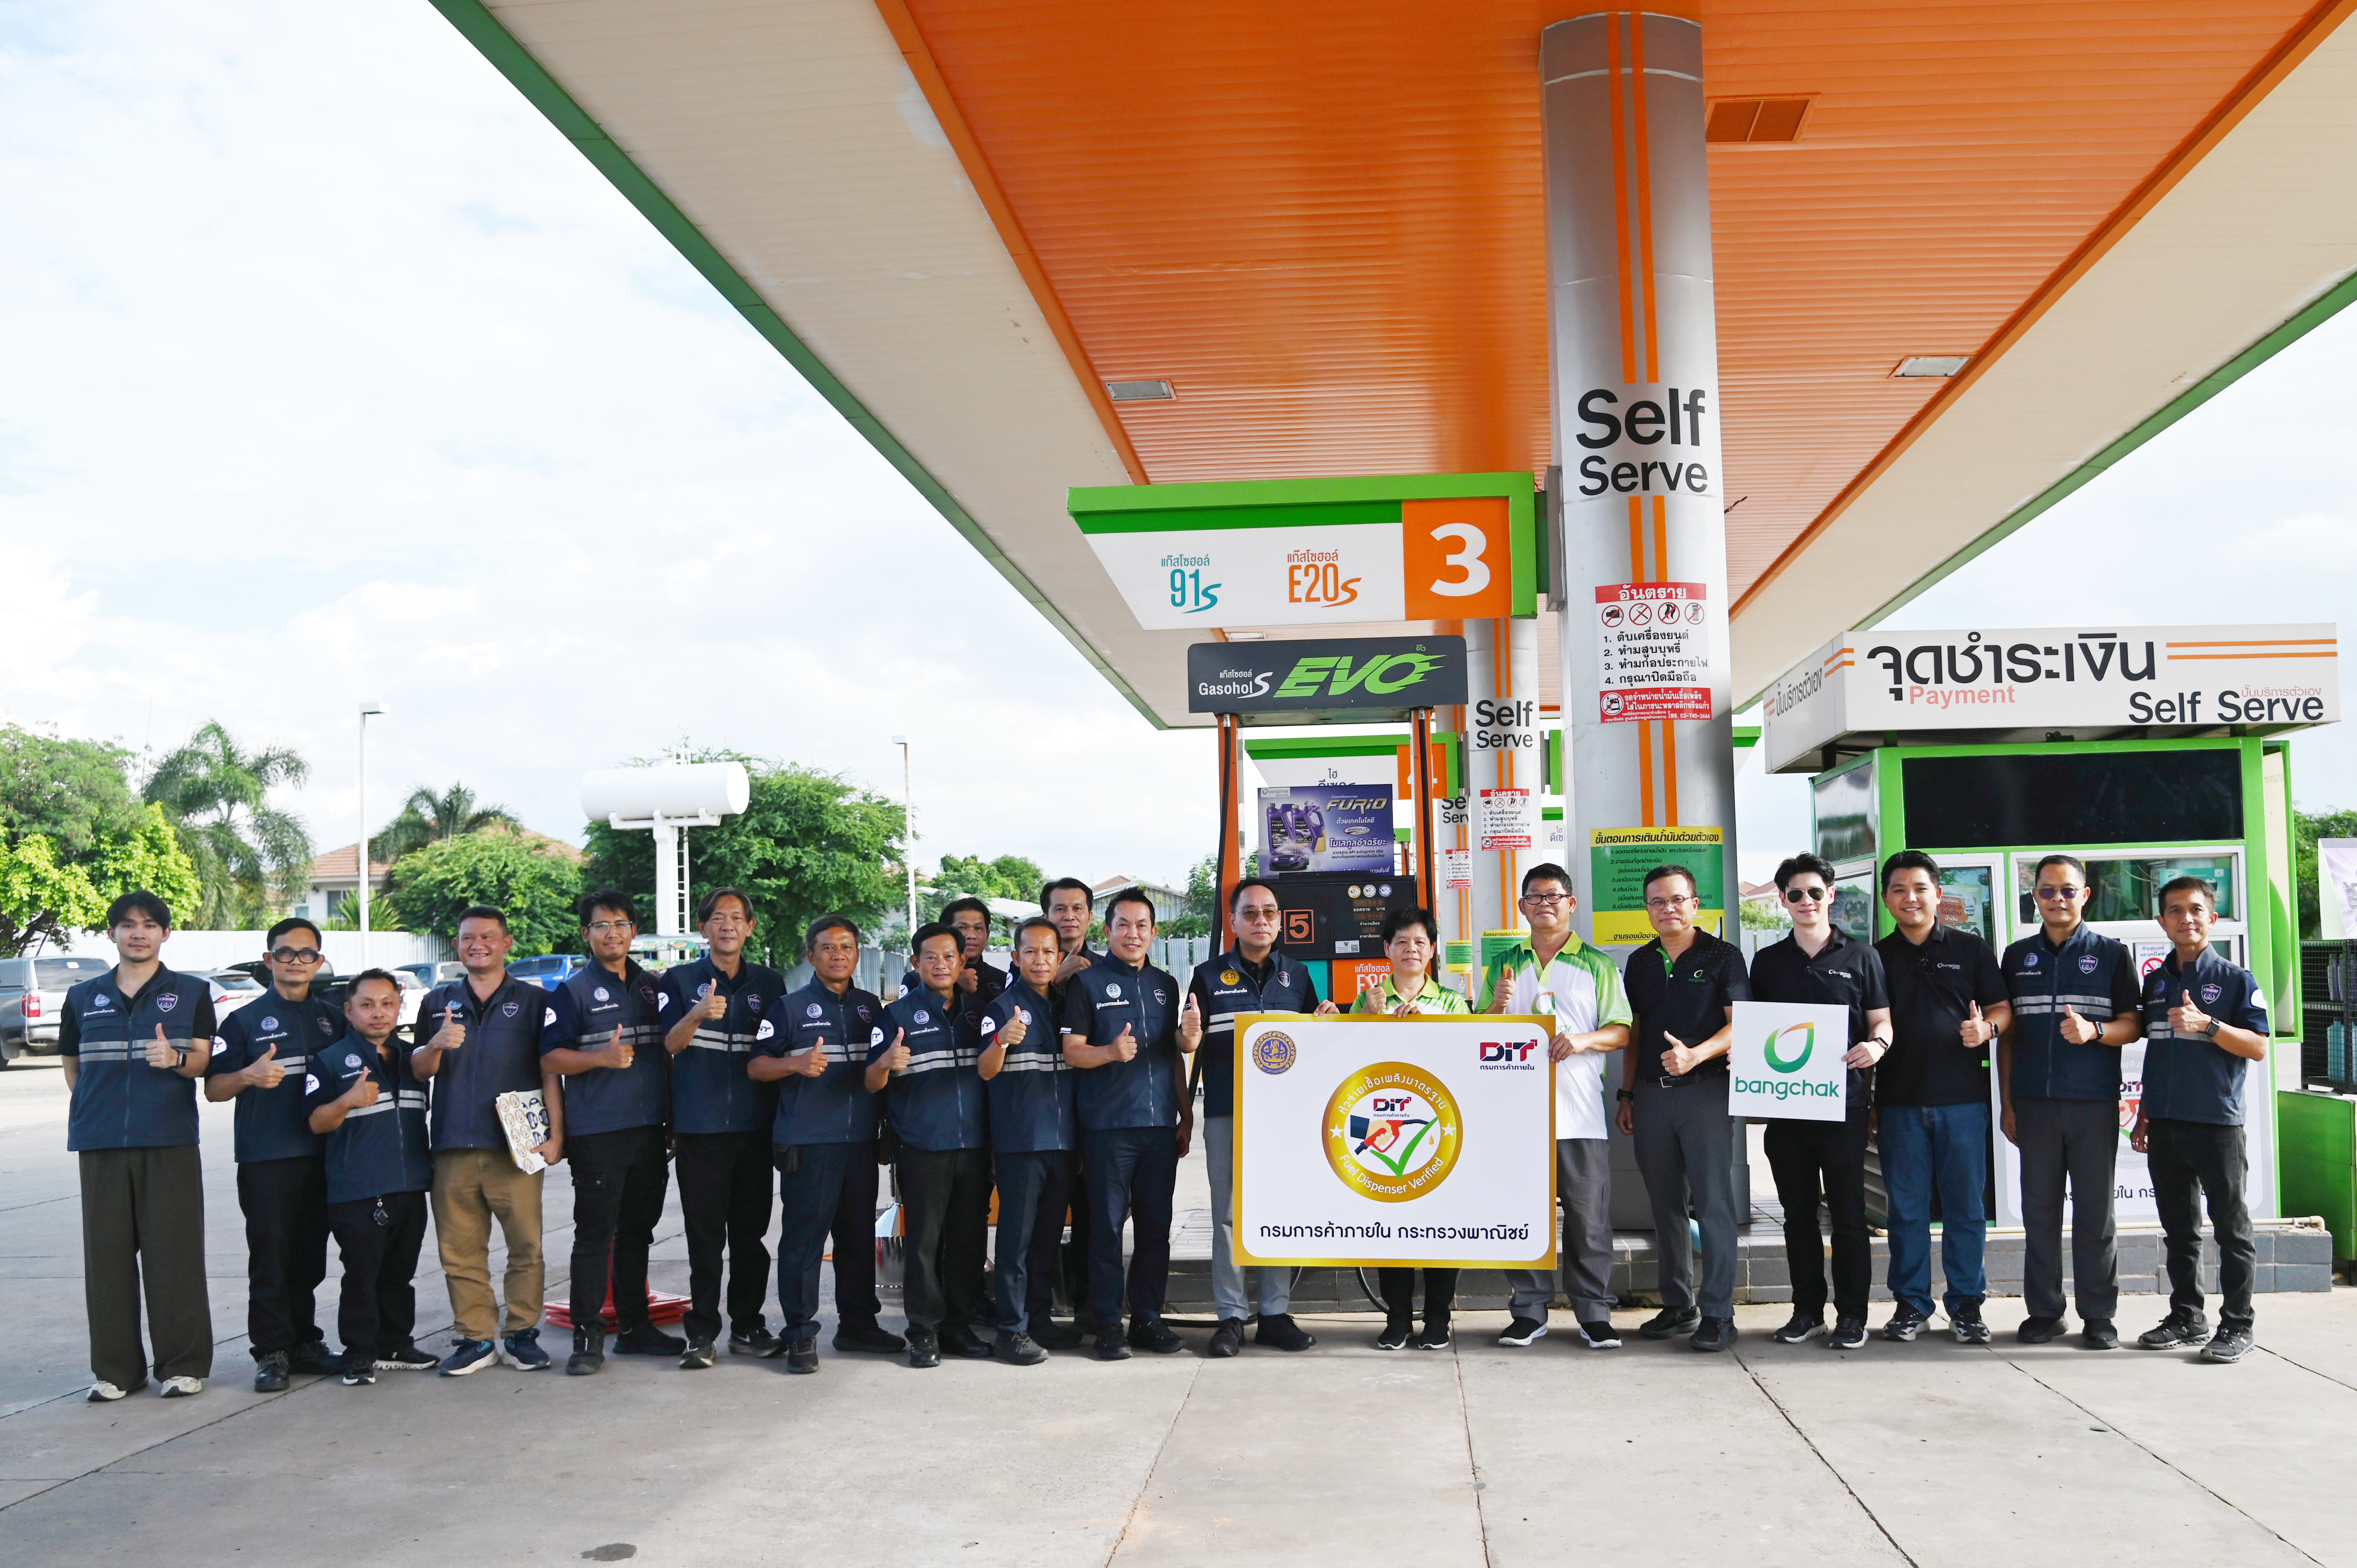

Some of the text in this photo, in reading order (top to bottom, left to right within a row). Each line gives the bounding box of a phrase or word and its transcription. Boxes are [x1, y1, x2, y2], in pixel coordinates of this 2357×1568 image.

[1576, 387, 1705, 449] Self
[1579, 455, 1708, 495] Serve
[1161, 553, 1210, 568] แก๊สโซฮอล์
[1287, 549, 1339, 564] แก๊สโซฮอล์
[1430, 522, 1491, 597] 3
[1618, 584, 1687, 601] อันตราย
[1617, 627, 1689, 642] ดับเครื่องยนต์
[1618, 640, 1681, 658] ห้ามสูบบุหรี่
[1618, 656, 1708, 669] ห้ามก่อประกายไฟ
[1867, 631, 2156, 701] จุดชำระเงิน
[1198, 680, 1253, 697] Gasohol
[1273, 653, 1447, 698] EVO
[1219, 669, 1253, 679] แก๊สโซฮอล์
[1619, 670, 1696, 687] กรุณาปิดมือถือ
[1909, 684, 2016, 709] Payment
[2128, 690, 2324, 723] Self Serve
[1475, 700, 1533, 727] Self
[1476, 730, 1533, 748] Serve
[1550, 832, 1563, 842] ดีเซ
[1289, 913, 1309, 939] 5
[1355, 962, 1390, 973] แก๊สโซฮอล์
[1339, 1073, 1447, 1114] หัวจ่ายเชื้อเพลิงมาตรฐาน
[1735, 1076, 1840, 1100] bangchak
[1339, 1153, 1444, 1194] Fuel Dispenser Verified
[1260, 1221, 1529, 1241] กรมการค้าภายใน กระทรวงพาณิชย์
